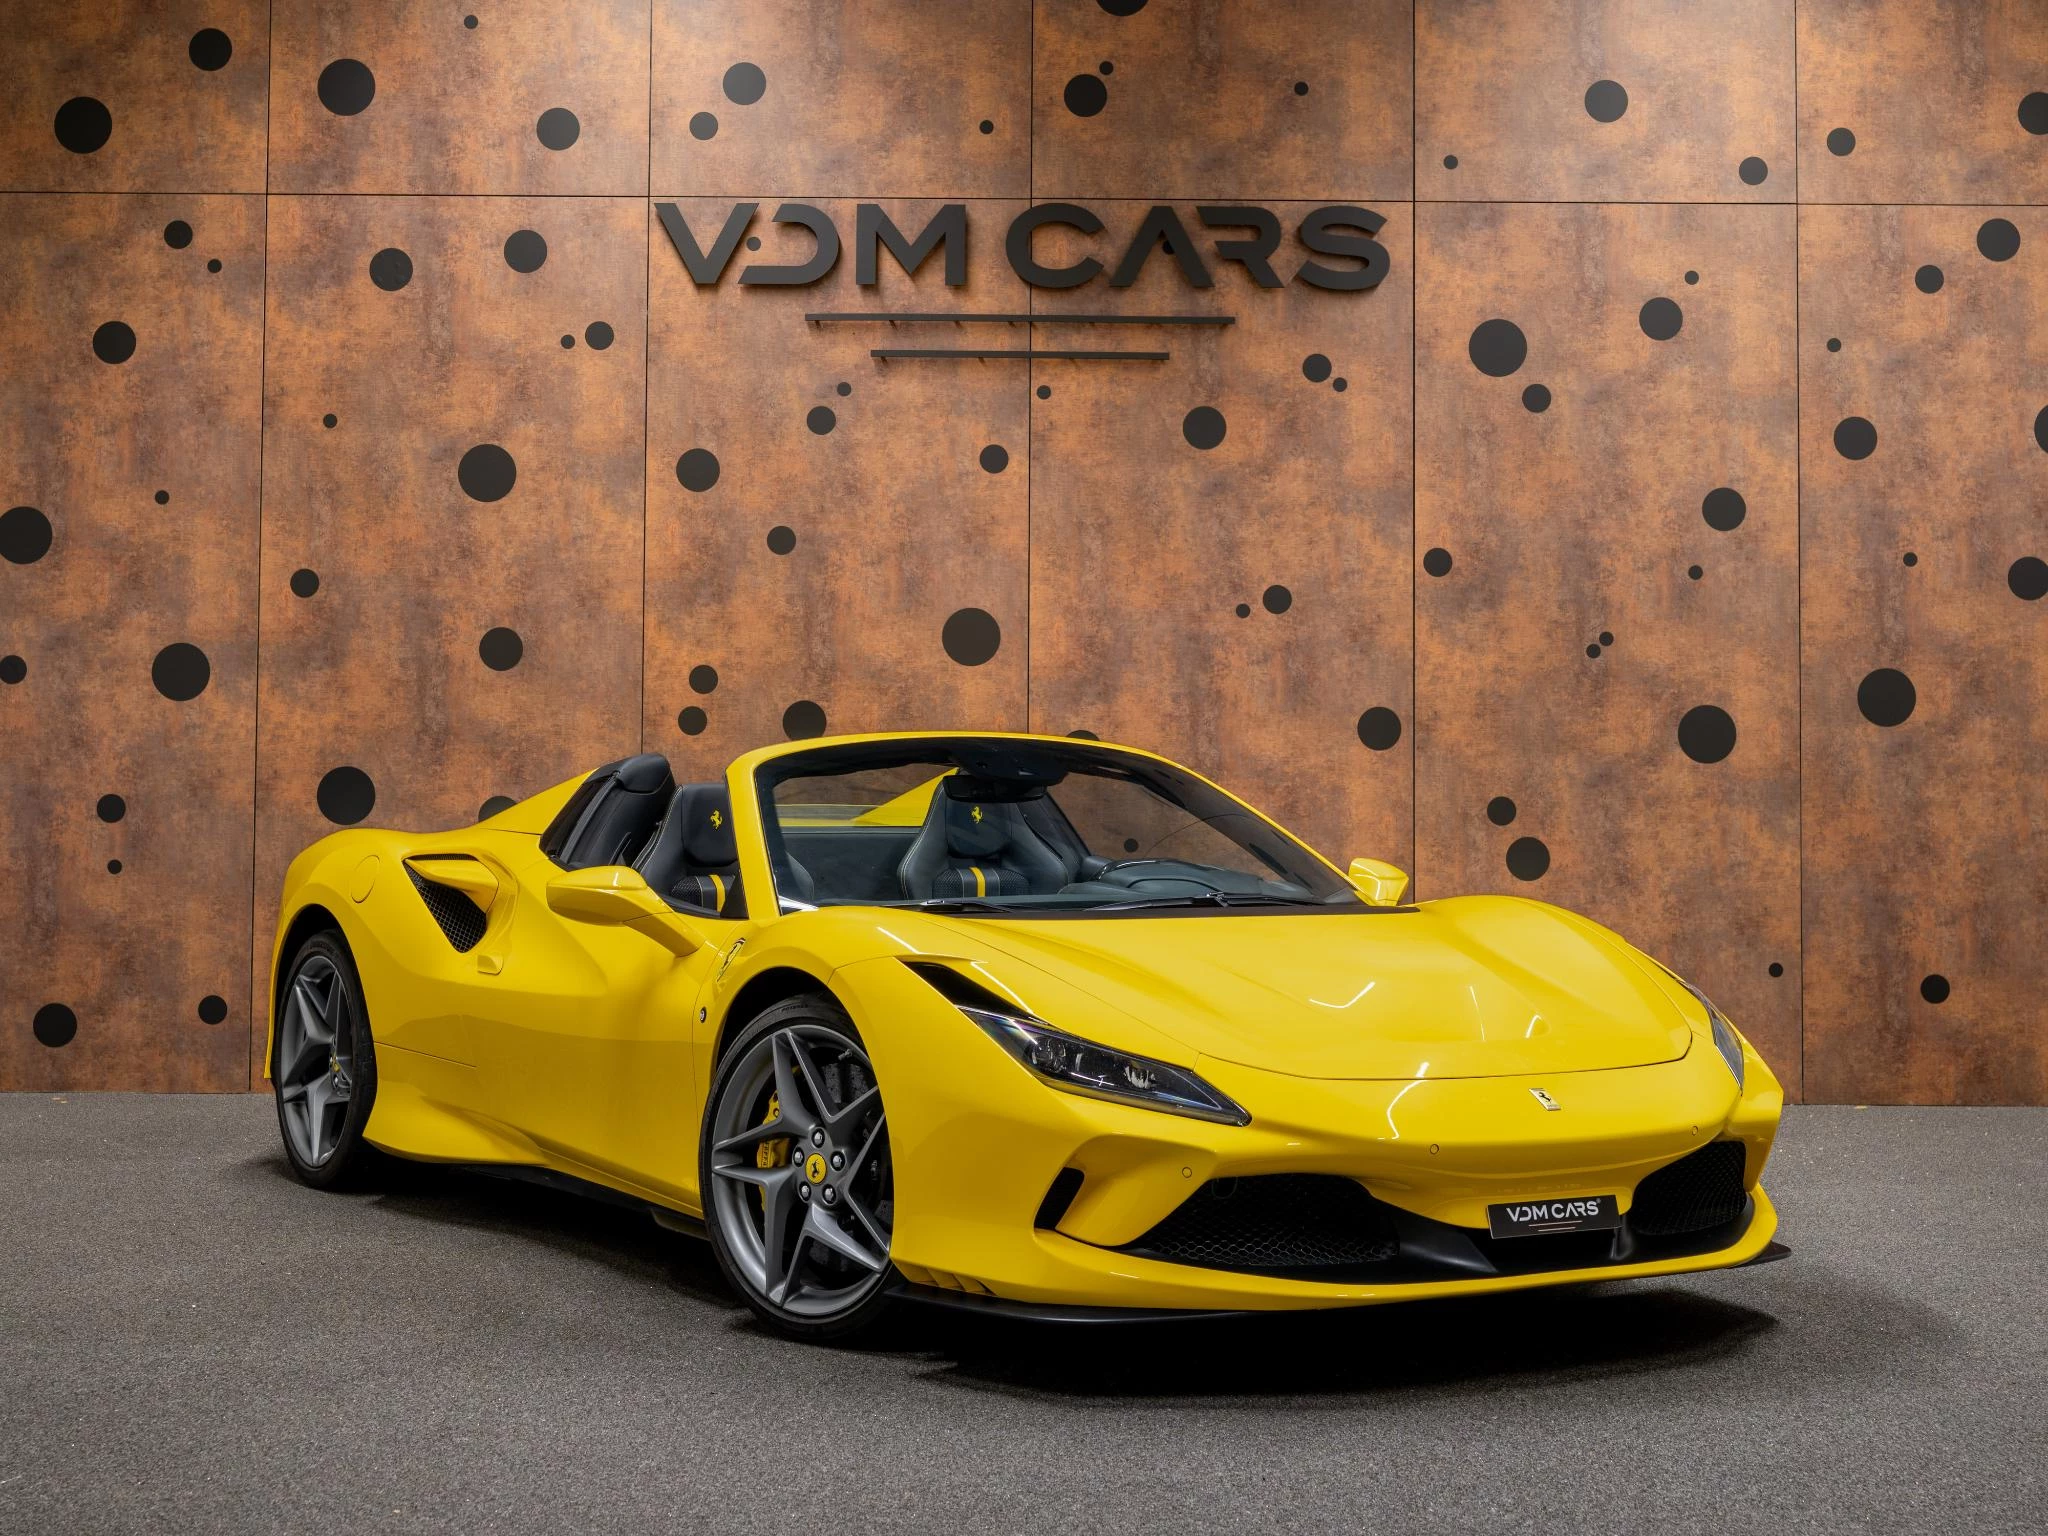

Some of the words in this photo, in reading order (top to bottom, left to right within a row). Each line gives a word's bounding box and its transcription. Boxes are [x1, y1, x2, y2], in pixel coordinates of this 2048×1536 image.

[656, 203, 966, 285] VDM
[1006, 203, 1389, 290] CARS
[1506, 1205, 1548, 1222] VDM
